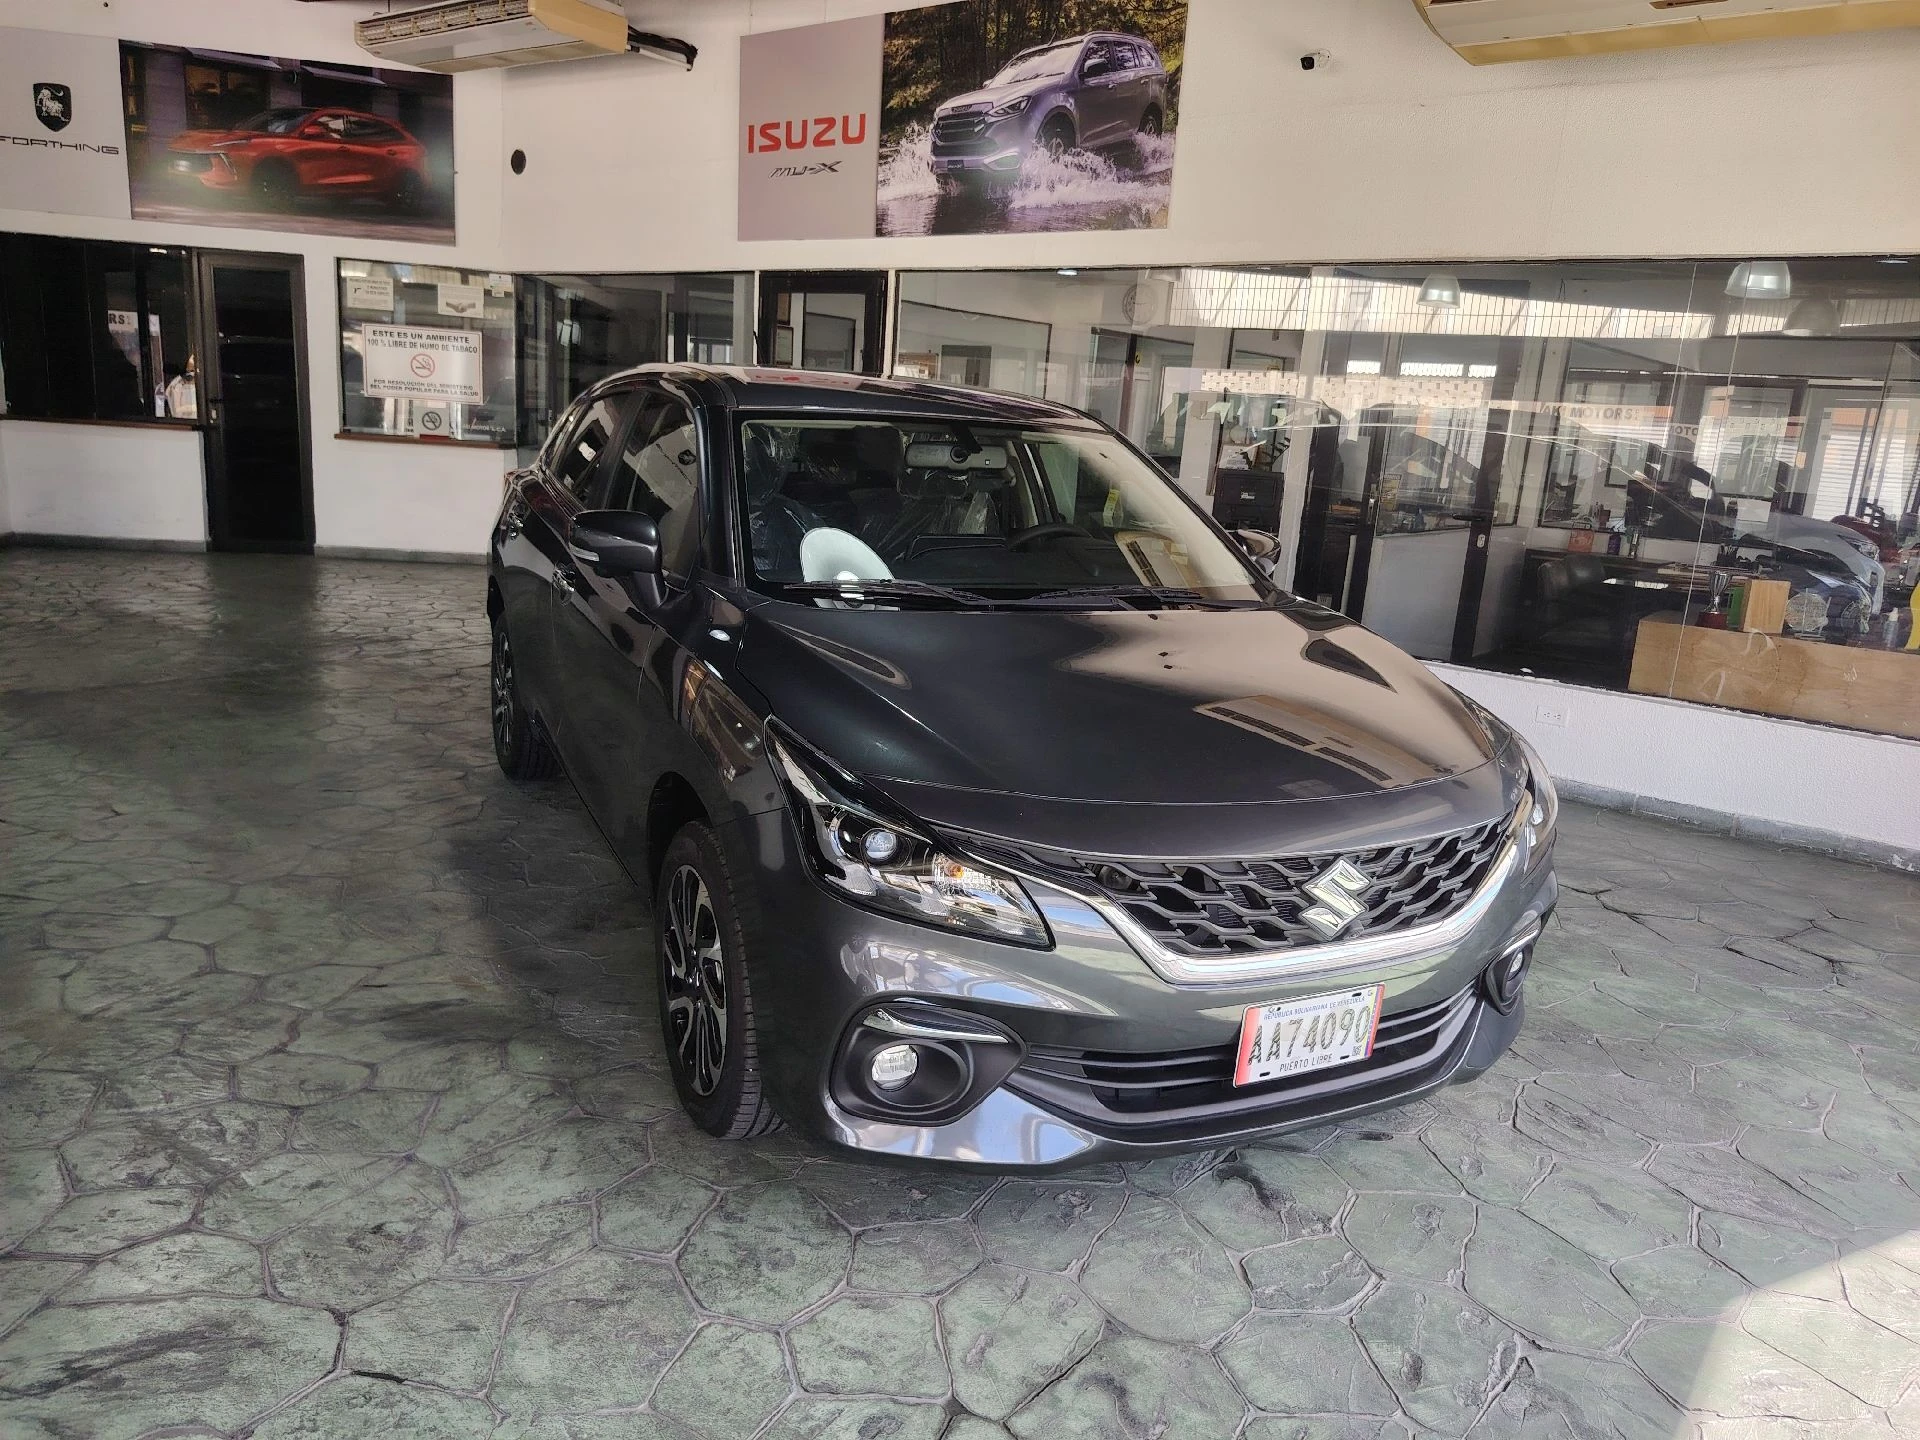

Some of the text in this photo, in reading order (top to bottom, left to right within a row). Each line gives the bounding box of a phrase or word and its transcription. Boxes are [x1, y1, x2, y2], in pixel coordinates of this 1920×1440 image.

[747, 113, 866, 154] ISUZU
[367, 338, 379, 346] 100
[388, 340, 408, 349] LIBRE
[420, 343, 440, 351] HUMO
[452, 345, 478, 354] TABACO
[373, 330, 395, 338] ESTE
[426, 334, 470, 344] AMBIENTE
[1248, 1006, 1370, 1066] AA74090
[1279, 1053, 1333, 1073] PUERTO LIBRE
